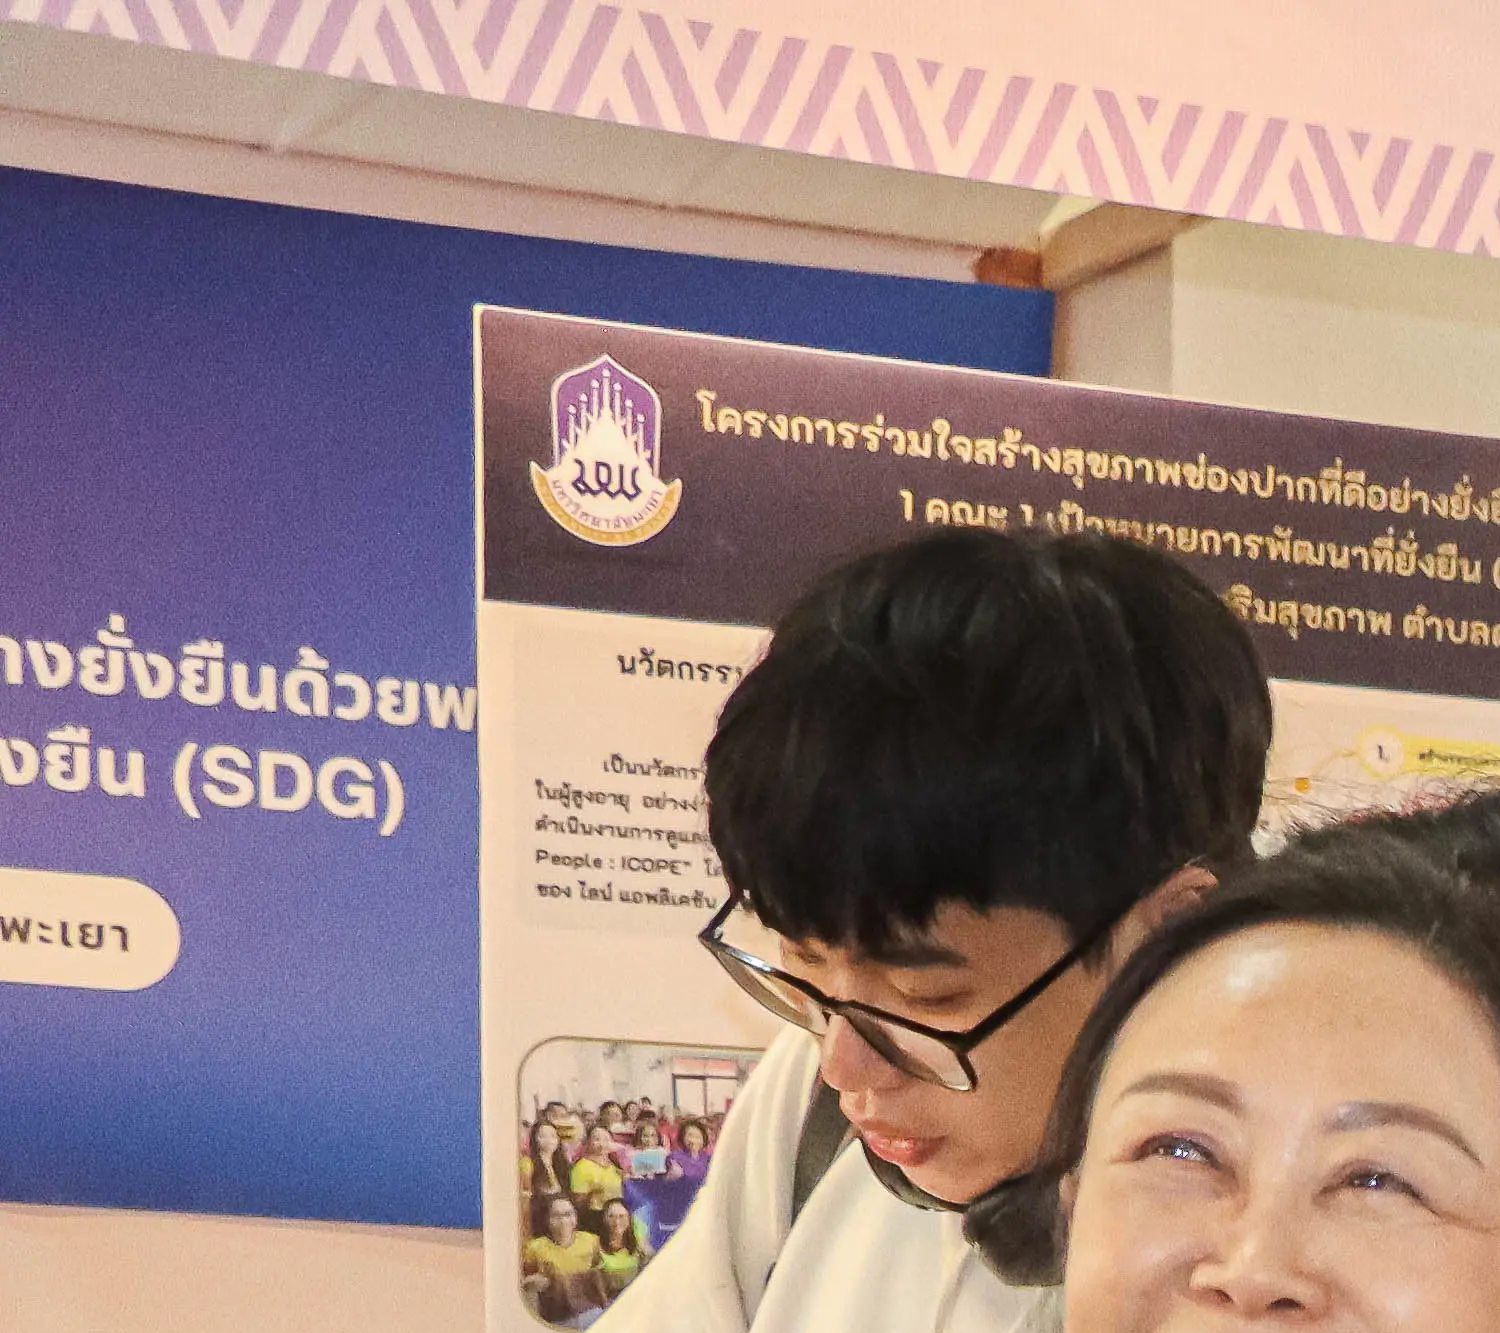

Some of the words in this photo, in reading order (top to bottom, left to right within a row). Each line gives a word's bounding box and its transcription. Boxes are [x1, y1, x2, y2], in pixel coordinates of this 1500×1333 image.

[900, 488, 915, 522] 1
[173, 741, 406, 838] (SDG)
[535, 849, 604, 871] People
